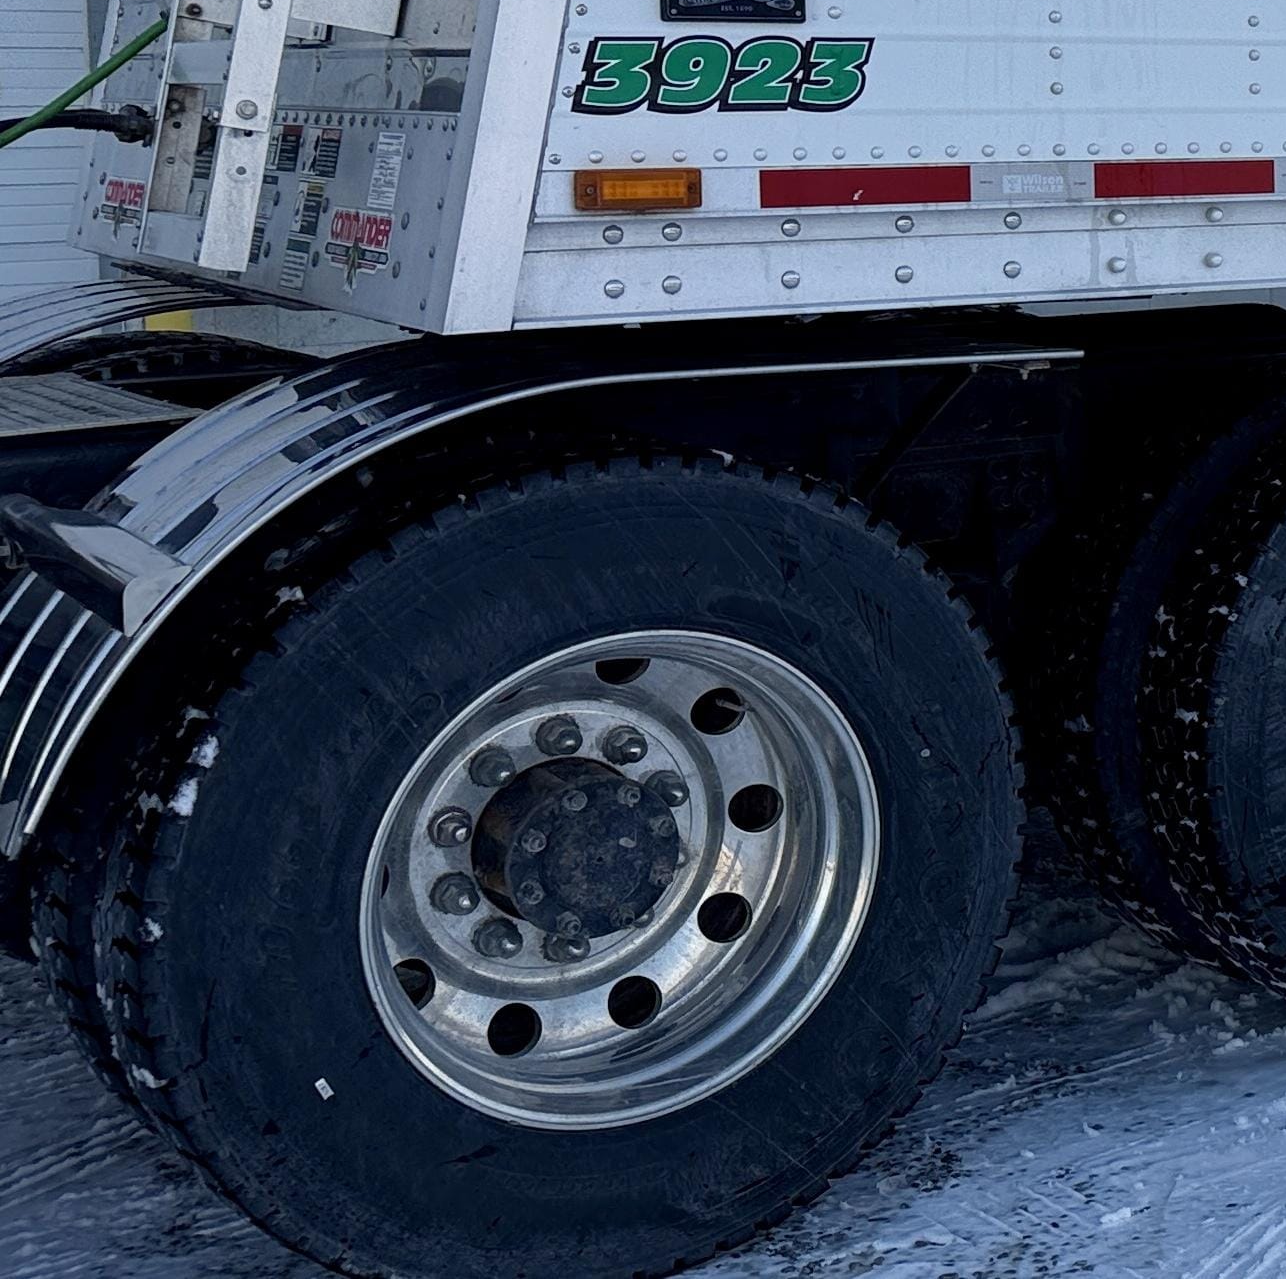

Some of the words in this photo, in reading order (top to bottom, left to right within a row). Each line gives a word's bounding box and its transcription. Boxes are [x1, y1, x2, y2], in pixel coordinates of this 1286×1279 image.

[571, 35, 875, 115] 3923
[1023, 174, 1064, 185] Wilson
[1023, 185, 1064, 193] TRAILER
